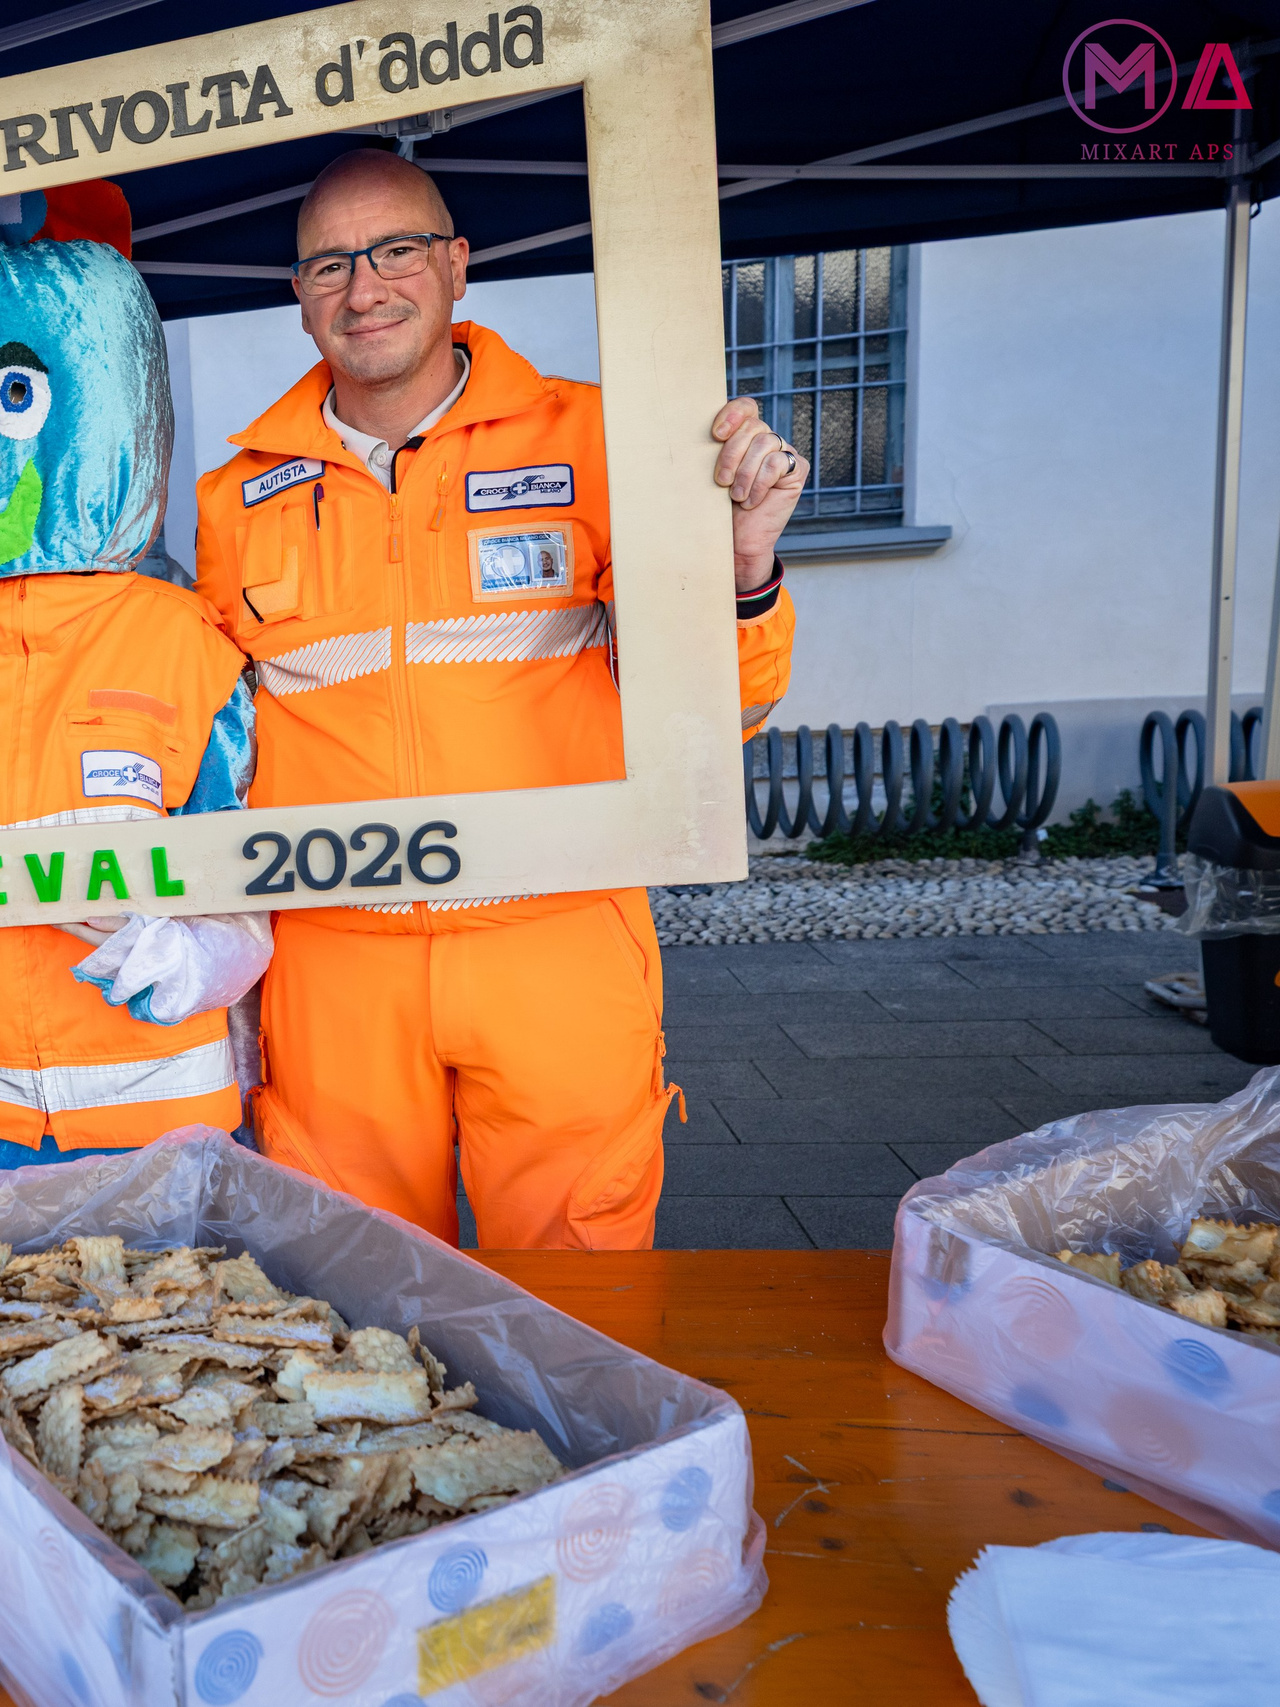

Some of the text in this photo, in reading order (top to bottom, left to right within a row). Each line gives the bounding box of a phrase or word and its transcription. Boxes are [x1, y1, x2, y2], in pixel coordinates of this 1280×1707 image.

[315, 5, 545, 107] d'adda
[258, 464, 307, 494] AUTISTA
[480, 482, 562, 496] CROCE BIANCA
[92, 770, 120, 778] CROCE
[242, 819, 462, 896] 2026
